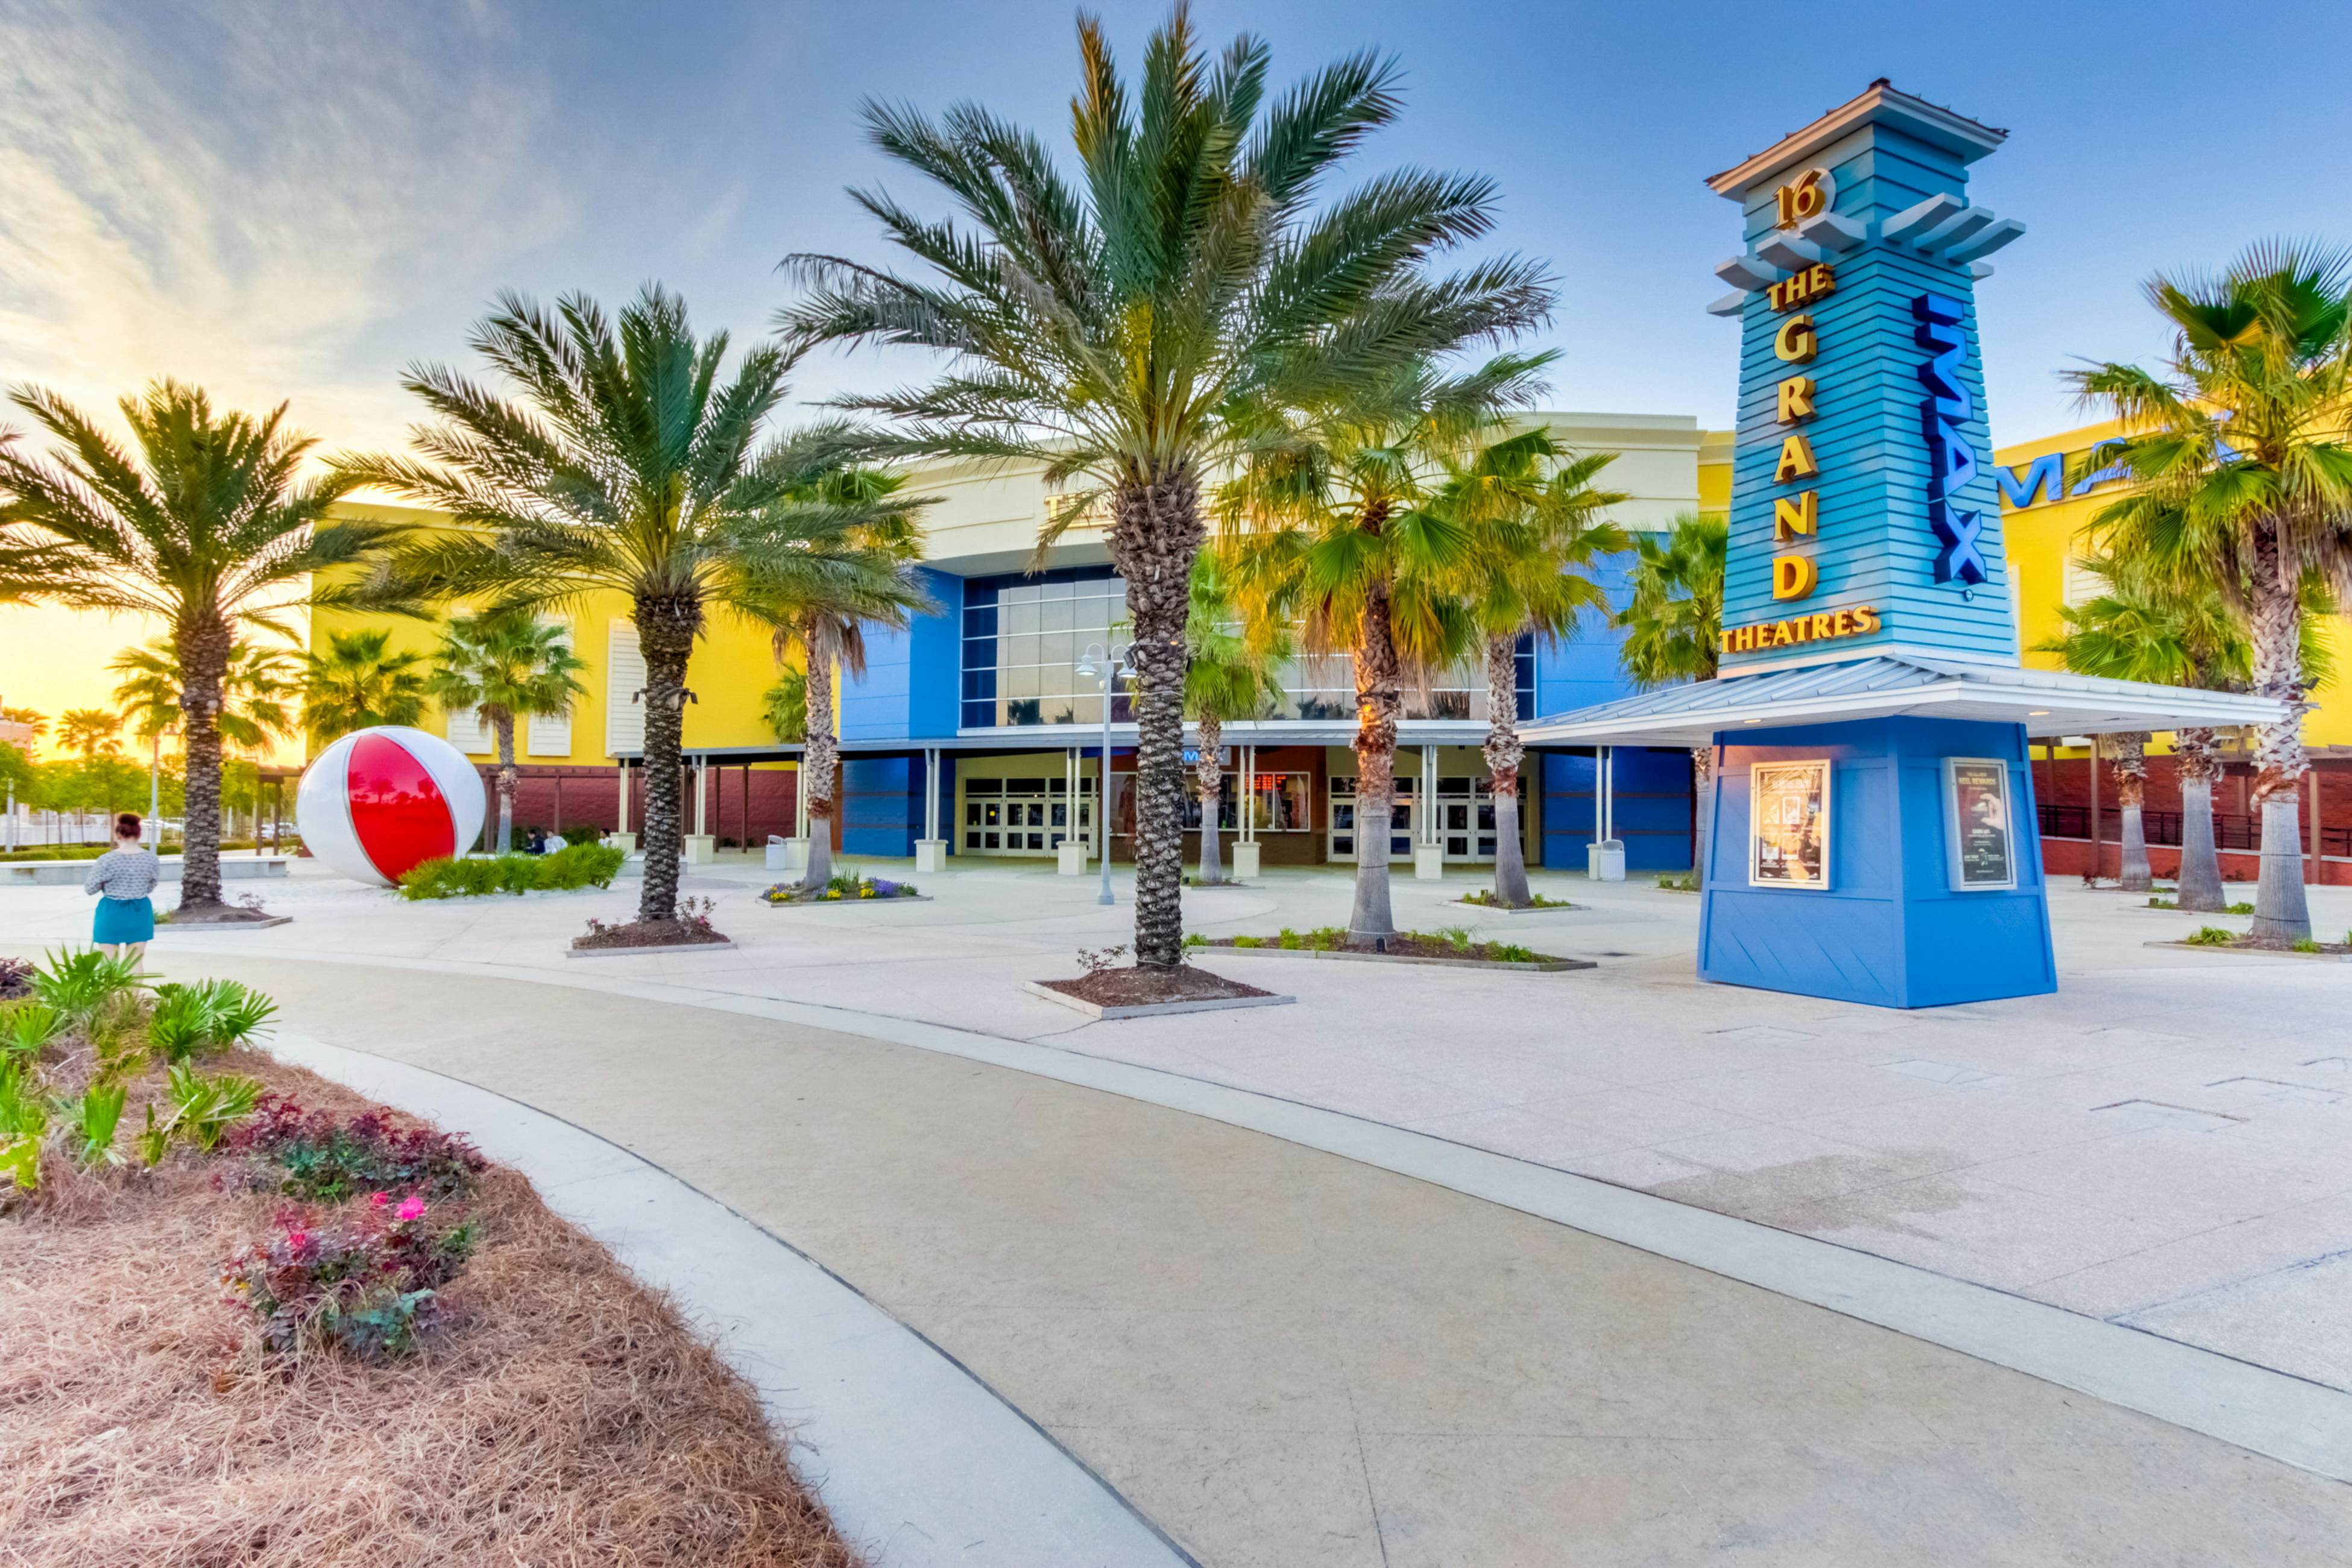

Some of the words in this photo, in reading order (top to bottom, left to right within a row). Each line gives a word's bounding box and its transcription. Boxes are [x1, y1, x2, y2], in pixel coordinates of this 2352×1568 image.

[1773, 169, 1824, 230] 16
[1765, 263, 1835, 312] THE
[1771, 313, 1817, 602] GRAND
[1914, 292, 1988, 585] IMAX
[1718, 605, 1880, 653] THEATRES
